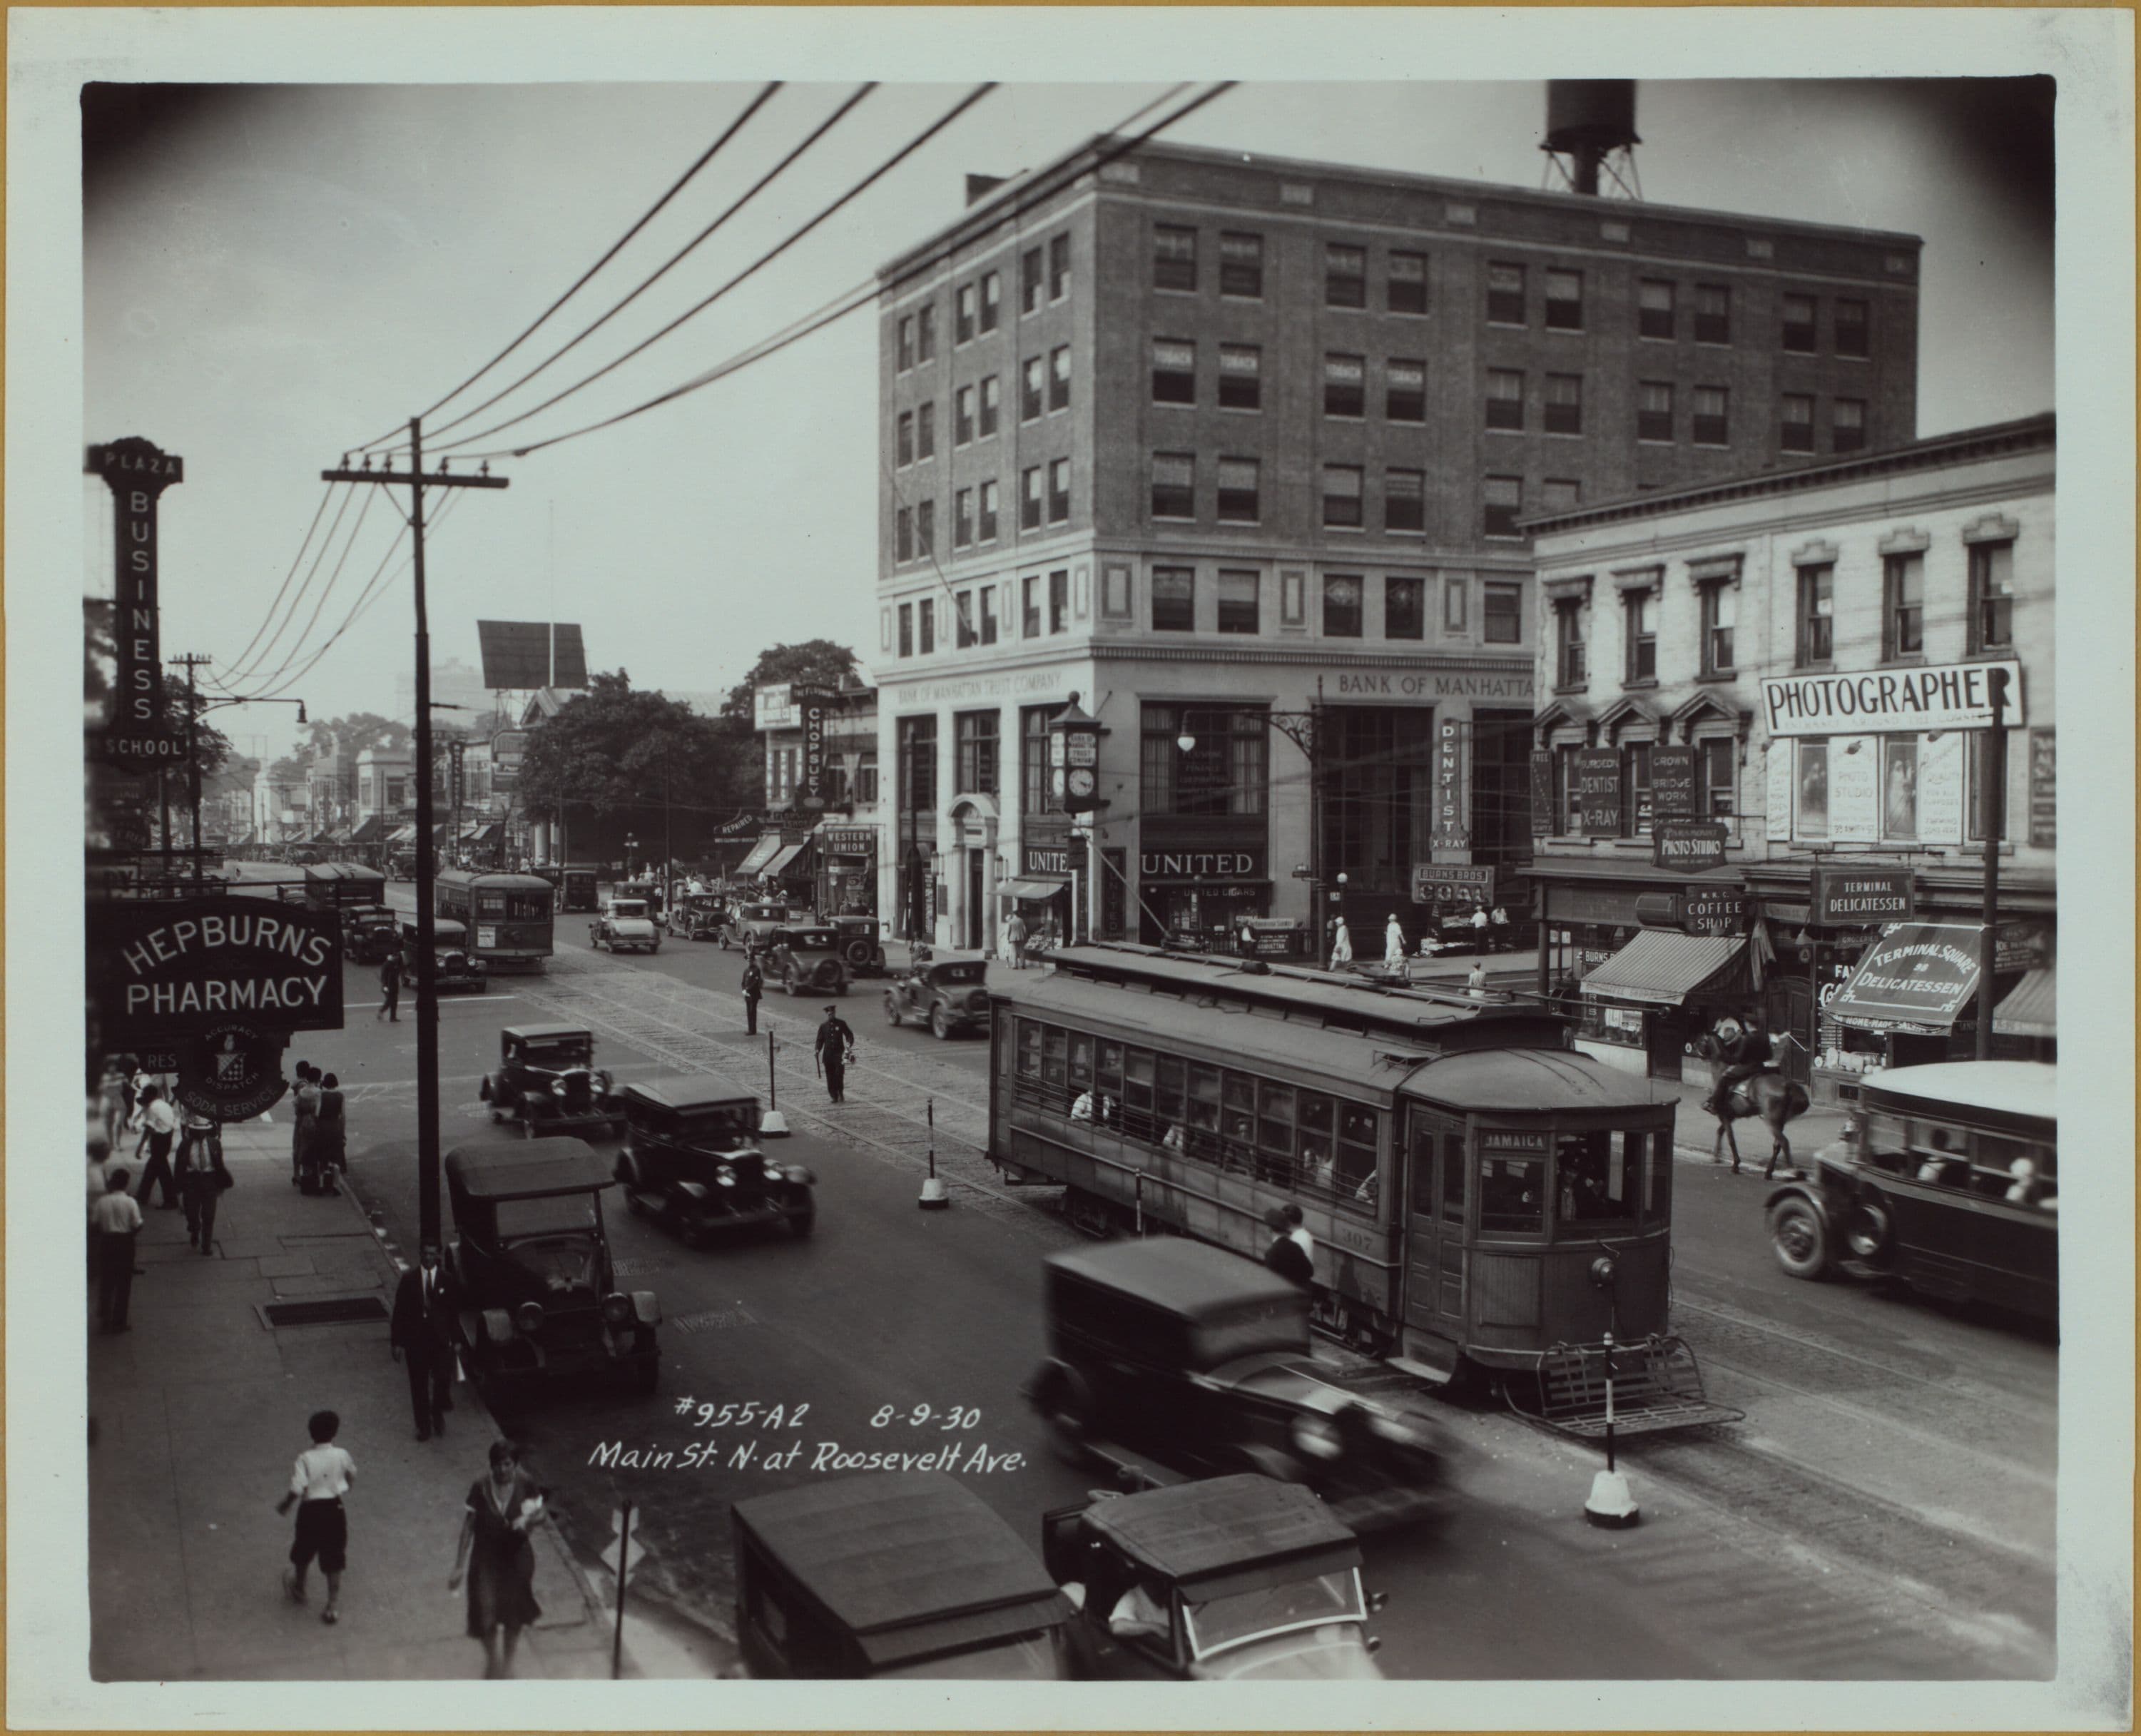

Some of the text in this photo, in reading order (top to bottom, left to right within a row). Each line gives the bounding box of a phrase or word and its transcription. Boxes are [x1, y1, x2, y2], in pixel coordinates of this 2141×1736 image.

[106, 452, 177, 474] PLAZA
[131, 492, 153, 720] BUSINESS
[1015, 672, 1062, 692] COMPANY
[1339, 674, 1535, 698] BANK OF MANHATTA
[1766, 666, 2013, 731] PHOTOGRAPHER
[106, 738, 183, 756] SCHOOL
[808, 707, 820, 797] CHOP SUEY
[1653, 756, 1689, 766] CROWN
[1442, 725, 1454, 832] DENTIST
[1580, 776, 1619, 793] DENTIST
[1657, 791, 1688, 801] WORK
[722, 814, 753, 834] REPAIRED
[1582, 810, 1619, 826] X-RAY
[828, 831, 871, 841] WESTERN
[1433, 839, 1467, 848] X-RAY
[834, 843, 865, 851] UNION
[1662, 838, 1722, 855] PHOTO STUDIO
[1029, 851, 1068, 872] UNITE
[1141, 853, 1253, 874] UNITED
[1422, 868, 1454, 880] BURNS
[1420, 884, 1490, 902] COAL
[1844, 882, 1892, 893] TERMINAL
[1688, 902, 1742, 915] COFFEE
[1830, 897, 1906, 913] DELICATESSEN
[1697, 918, 1732, 930] SHOP
[1873, 944, 1941, 968] TERMINAL
[1938, 945, 1977, 975] SQUARE
[1857, 972, 1964, 995] DELICATESSEN
[127, 975, 328, 1015] PHARMACY
[204, 1024, 260, 1044] ACCURACY
[204, 1072, 262, 1092] DISPATCH
[184, 1084, 280, 1117] SODA SERVICE
[1485, 1134, 1544, 1148] JAMAICA
[1342, 1229, 1373, 1251] 307
